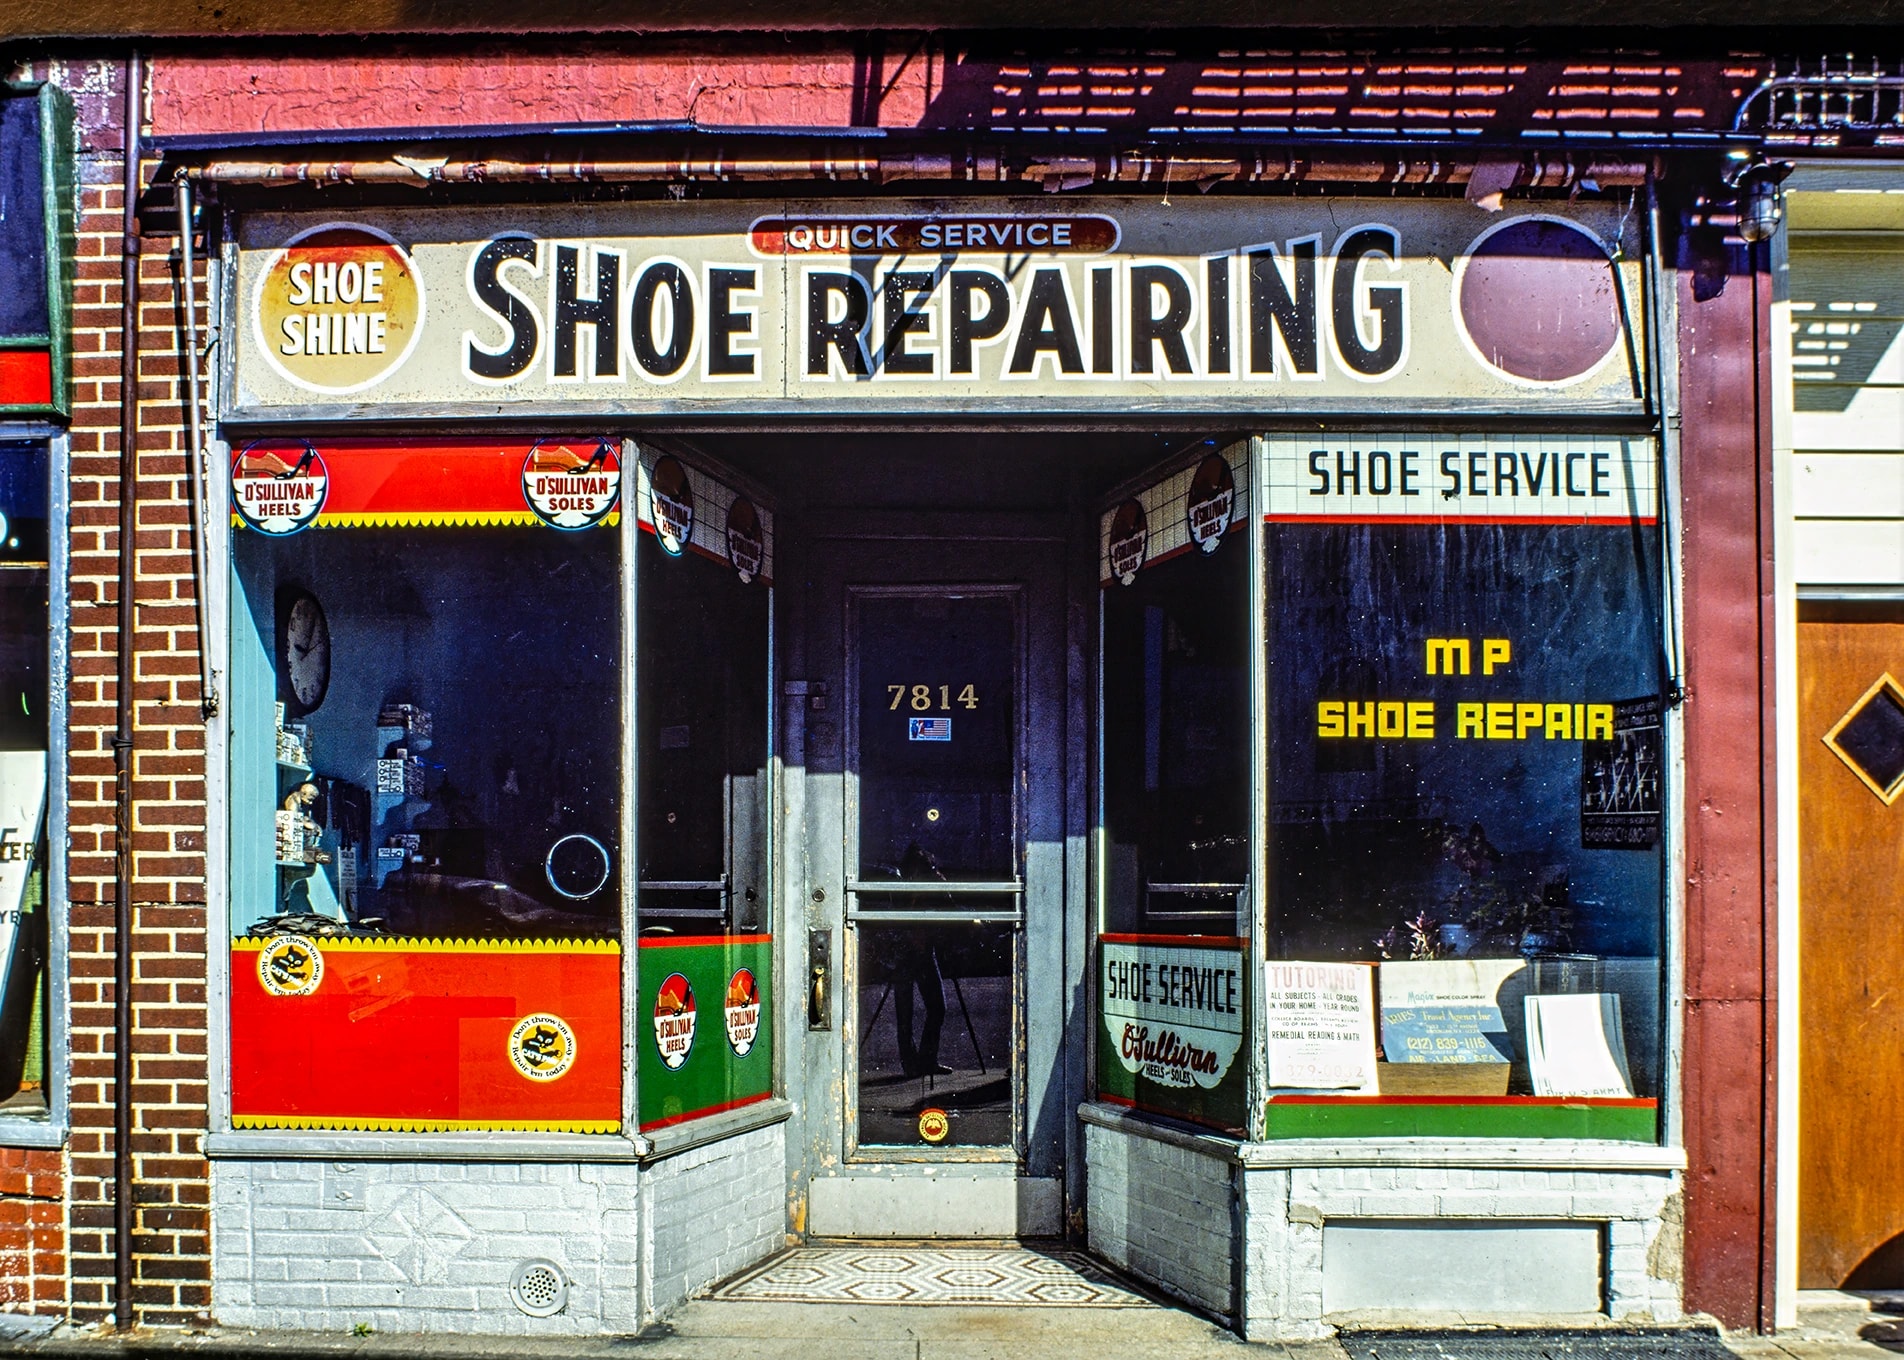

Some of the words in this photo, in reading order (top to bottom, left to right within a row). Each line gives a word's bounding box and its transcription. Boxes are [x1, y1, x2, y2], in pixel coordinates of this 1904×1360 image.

[787, 224, 899, 252] QUICK
[919, 223, 1072, 249] SERVICE
[288, 261, 384, 305] SHOE
[465, 234, 759, 383] SHOE
[804, 226, 1406, 379] REPAIRING
[280, 313, 386, 356] SHINE
[1309, 450, 1419, 496] SHOE
[1441, 451, 1610, 498] SERVICE
[245, 482, 314, 501] O'SULLIVAN
[537, 475, 608, 495] O'SULLIVAN
[259, 503, 301, 516] HEELS
[549, 497, 595, 511] SOLES
[1200, 519, 1222, 540] HEELS
[887, 684, 979, 711] 7814
[1318, 701, 1435, 738] SHOE
[1457, 703, 1614, 740] REPAIR
[286, 936, 310, 948] throw
[1108, 960, 1151, 1003] SHOE
[1159, 964, 1236, 1014] SERVICE
[1272, 966, 1356, 991] TUTORING
[1285, 992, 1316, 1000] SUBJECTS
[1336, 994, 1358, 1003] GRADES
[1341, 1004, 1359, 1012] ROUND
[1384, 1009, 1417, 1025] ARIES
[531, 1016, 557, 1024] throw
[734, 1027, 751, 1041] SOLES
[1271, 1031, 1305, 1040] REMEDIAL
[1308, 1031, 1335, 1040] READING
[1343, 1033, 1360, 1041] MATH
[1407, 1037, 1433, 1050] (212)
[666, 1038, 685, 1053] HEELS
[512, 1046, 529, 1071] Repair
[545, 1062, 567, 1077] today
